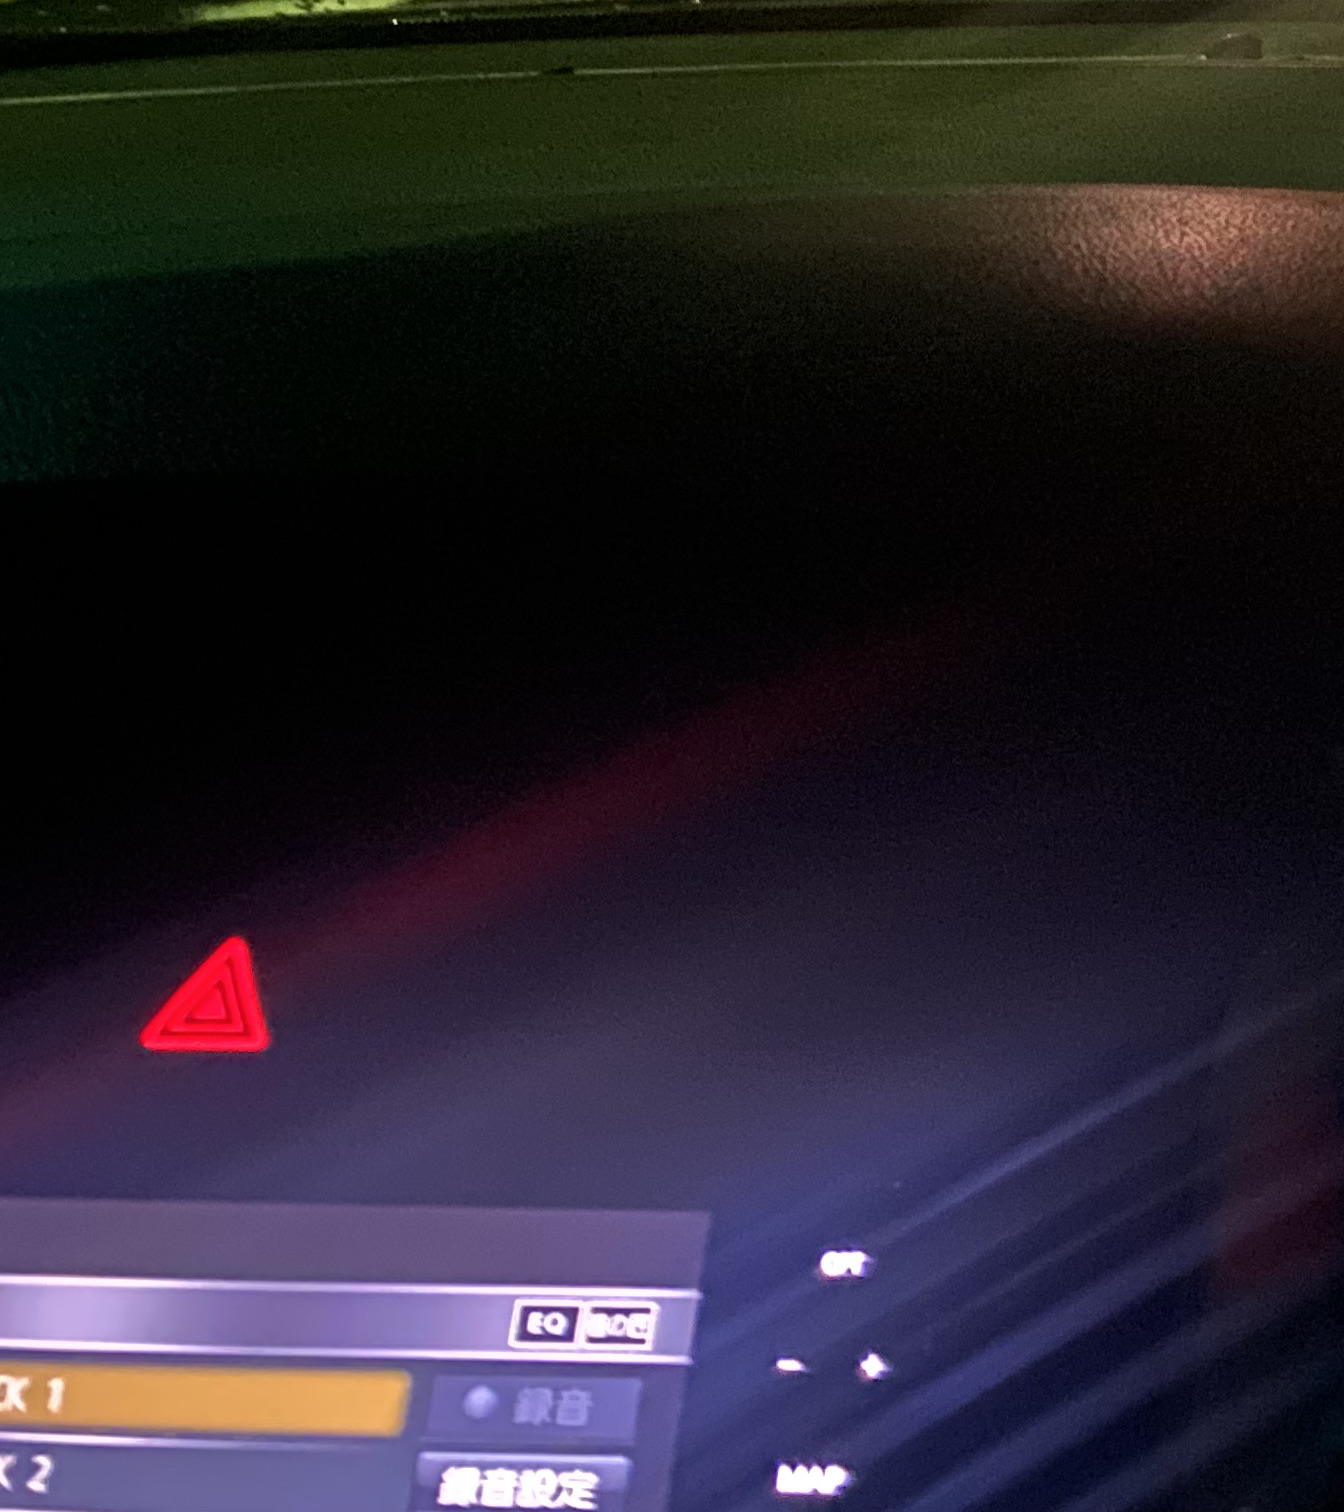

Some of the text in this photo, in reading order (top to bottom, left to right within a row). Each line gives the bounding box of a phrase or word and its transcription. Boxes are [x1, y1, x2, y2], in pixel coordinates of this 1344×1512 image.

[526, 1311, 568, 1335] EQ
[48, 1378, 64, 1412] 1
[514, 1388, 593, 1425] 録音
[26, 1455, 54, 1493] 2
[437, 1466, 599, 1510] 録音設定
